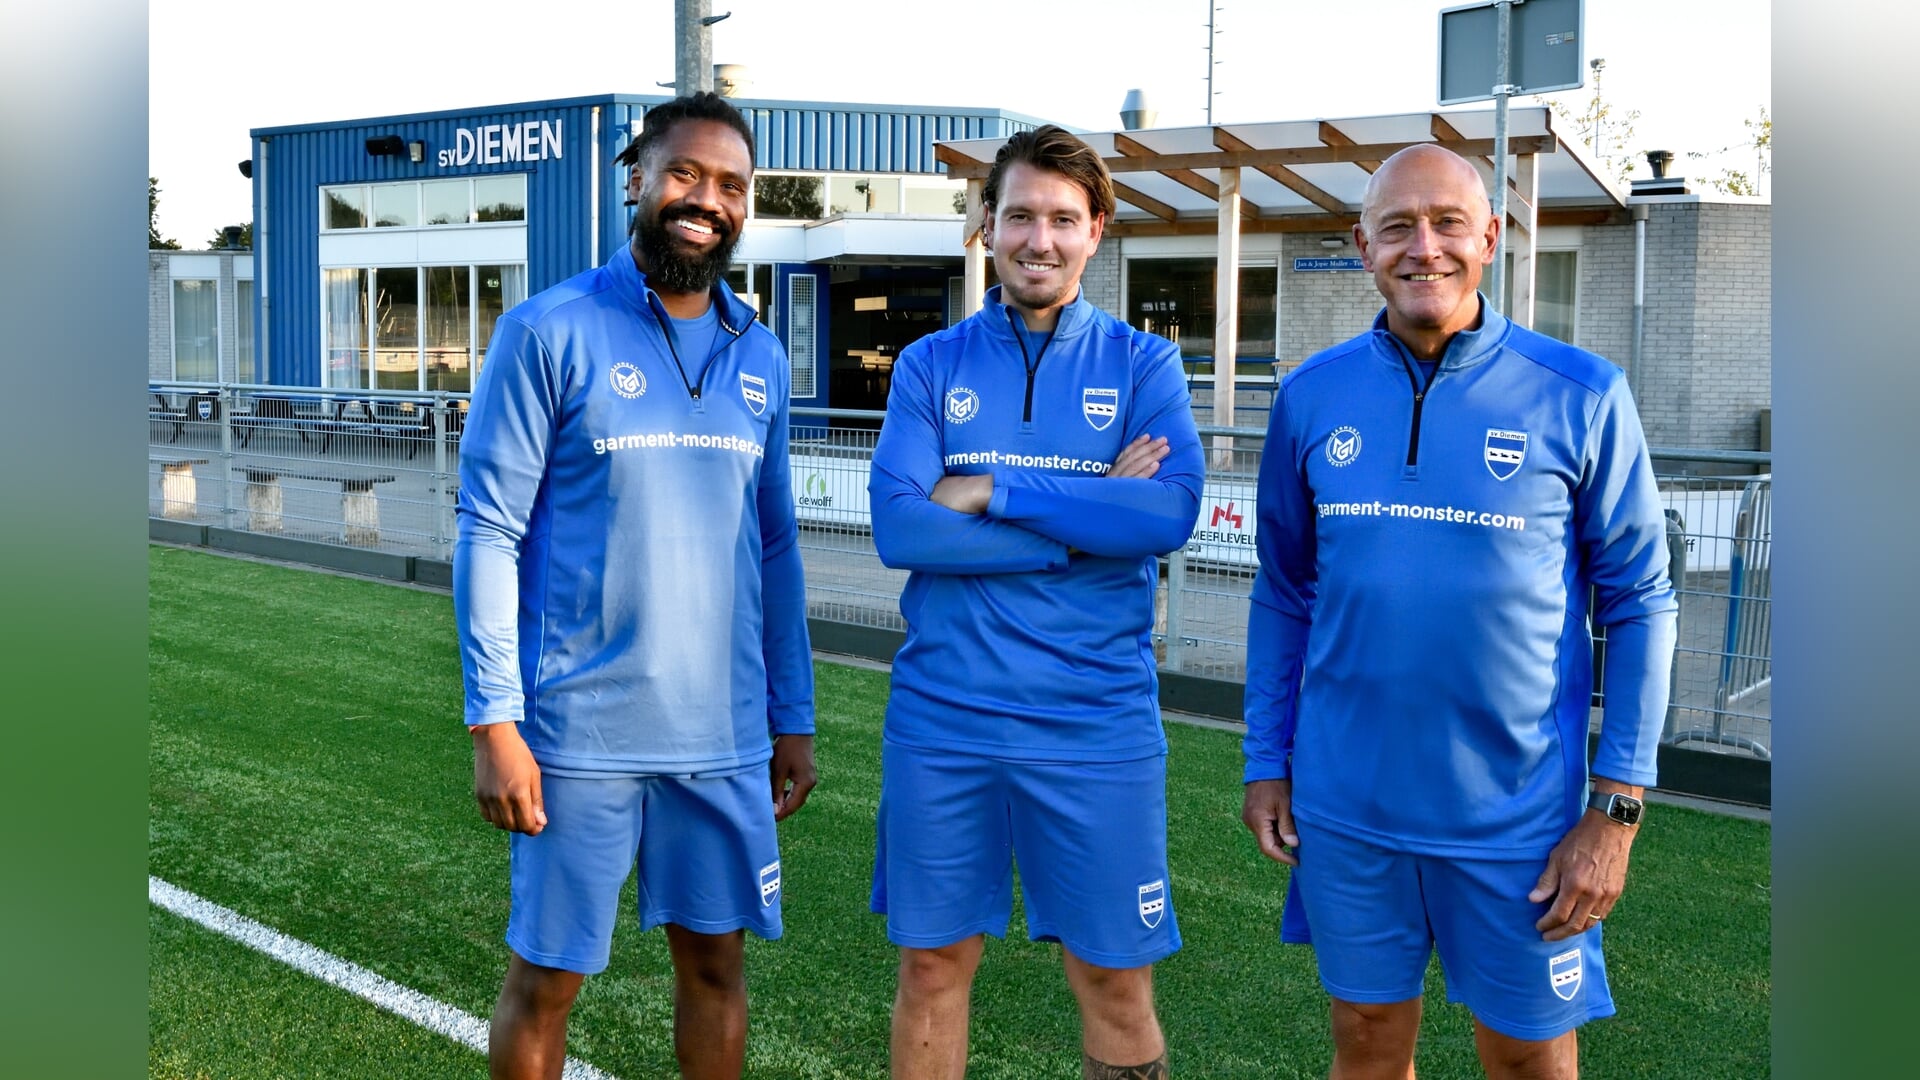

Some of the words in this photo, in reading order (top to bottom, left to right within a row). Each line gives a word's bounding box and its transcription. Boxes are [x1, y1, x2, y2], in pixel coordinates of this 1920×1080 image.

[456, 118, 563, 166] DIEMEN
[1500, 431, 1526, 440] Diemen
[944, 450, 1112, 474] arment-monster.com
[810, 495, 833, 507] wolff
[1317, 500, 1526, 531] garment-monster.com
